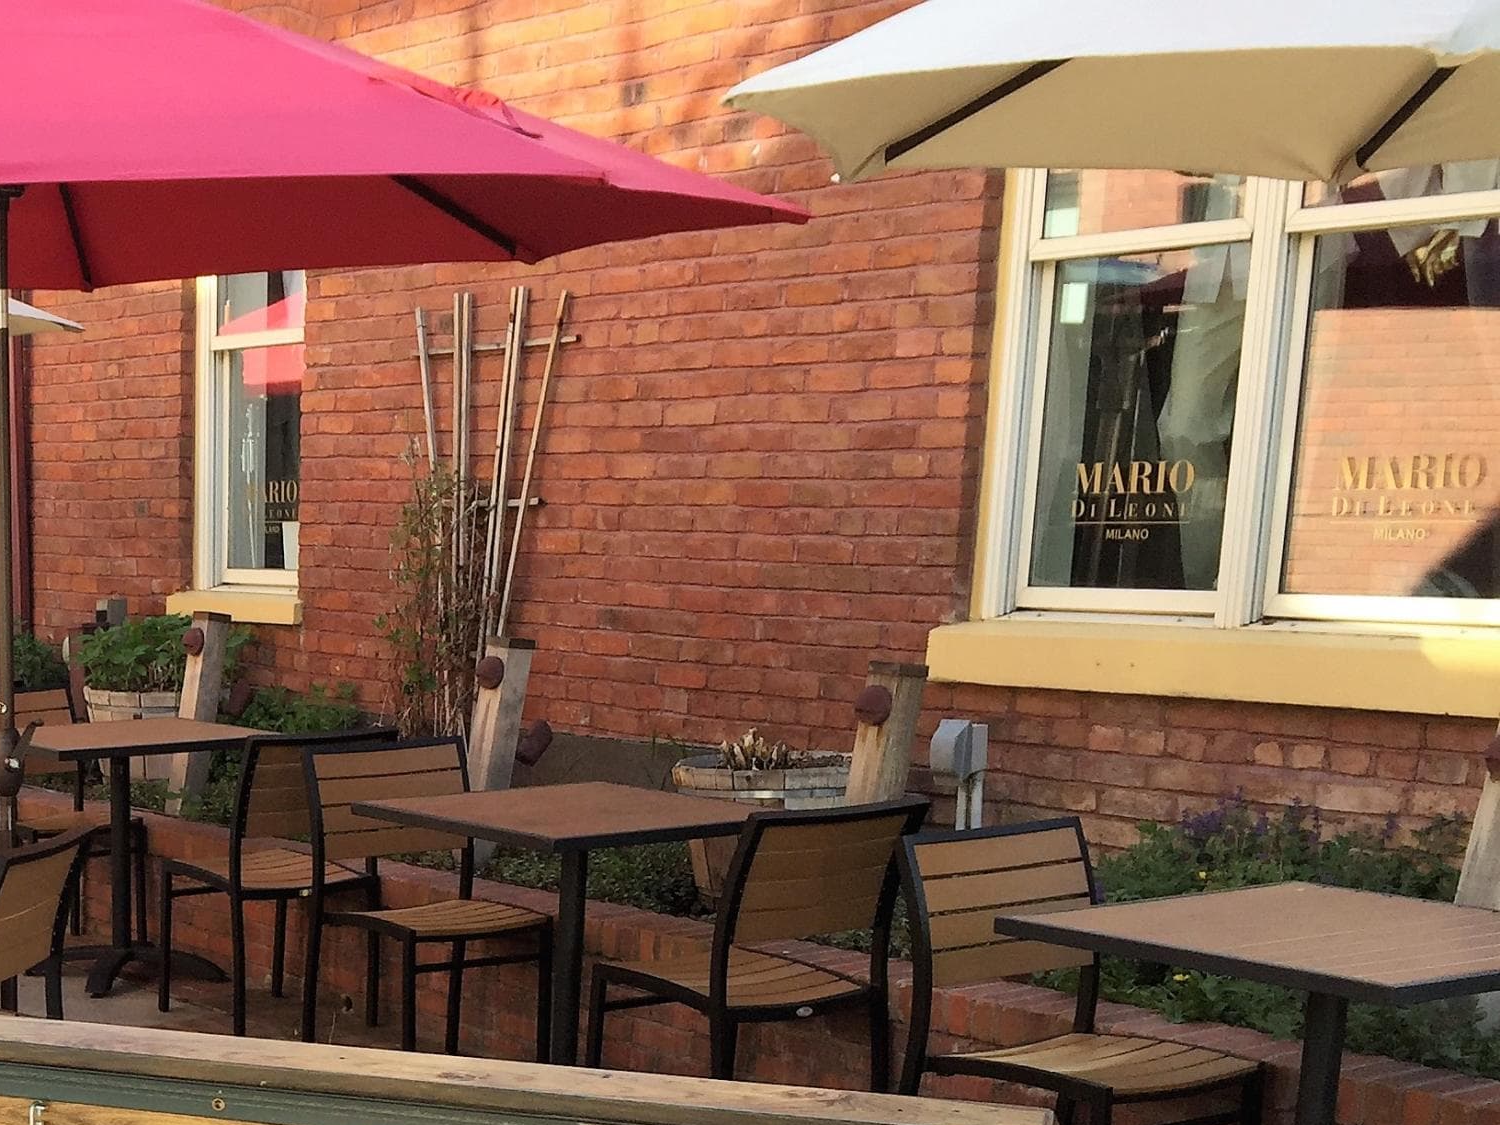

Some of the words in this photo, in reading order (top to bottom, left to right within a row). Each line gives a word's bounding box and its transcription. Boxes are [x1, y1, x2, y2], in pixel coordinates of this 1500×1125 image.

[1073, 459, 1195, 494] MARIO
[1333, 453, 1487, 490] MARIO
[265, 480, 297, 503] RIO
[1106, 529, 1149, 540] MILANO
[1373, 528, 1425, 540] MILANO
